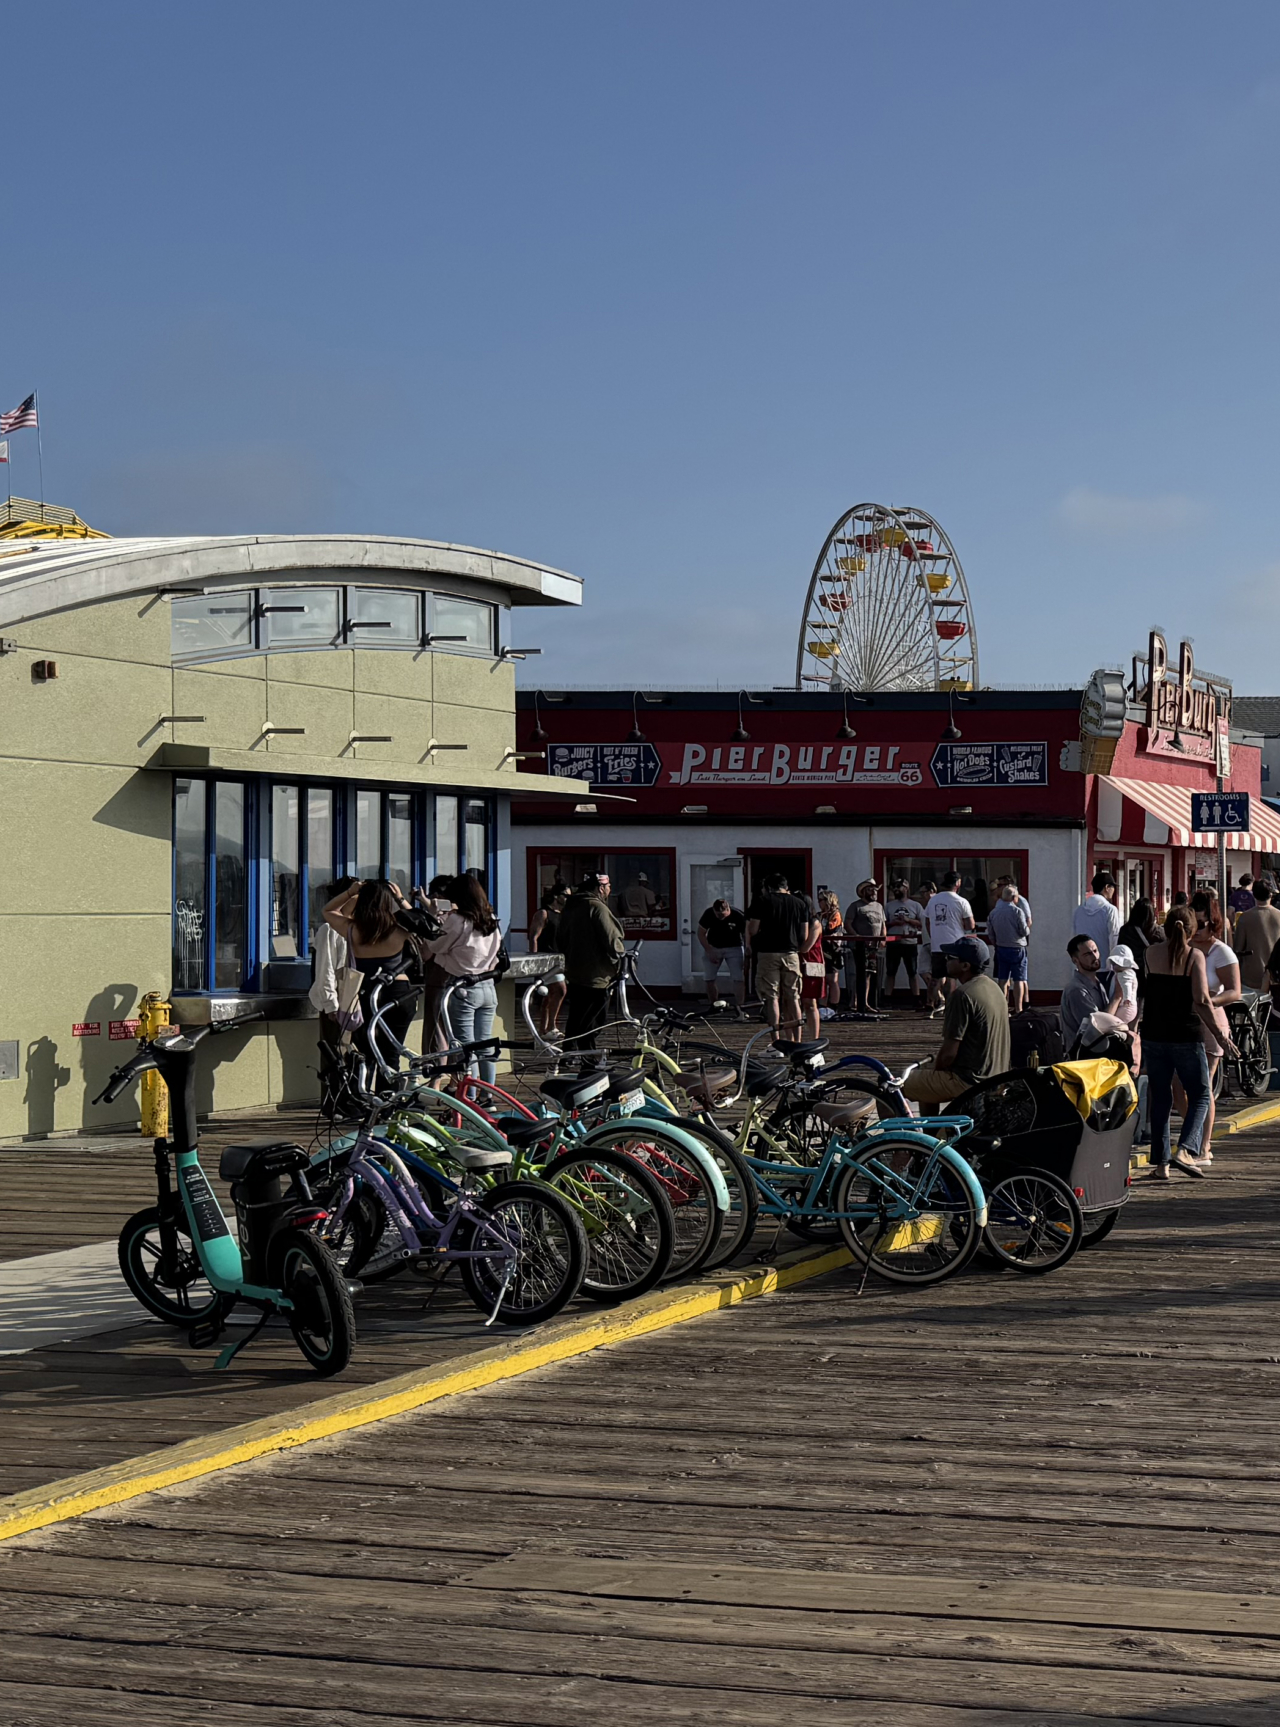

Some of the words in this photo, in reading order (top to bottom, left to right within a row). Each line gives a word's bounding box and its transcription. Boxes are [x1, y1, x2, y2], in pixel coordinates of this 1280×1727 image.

[571, 747, 595, 758] JUICY
[971, 746, 992, 754] FAMOUS
[553, 759, 594, 776] Burgers
[604, 755, 637, 773] Fries
[953, 758, 968, 776] Hot
[1000, 756, 1032, 774] Custard
[746, 773, 767, 781] Land
[900, 771, 919, 782] 66
[1008, 769, 1040, 783] Shakes
